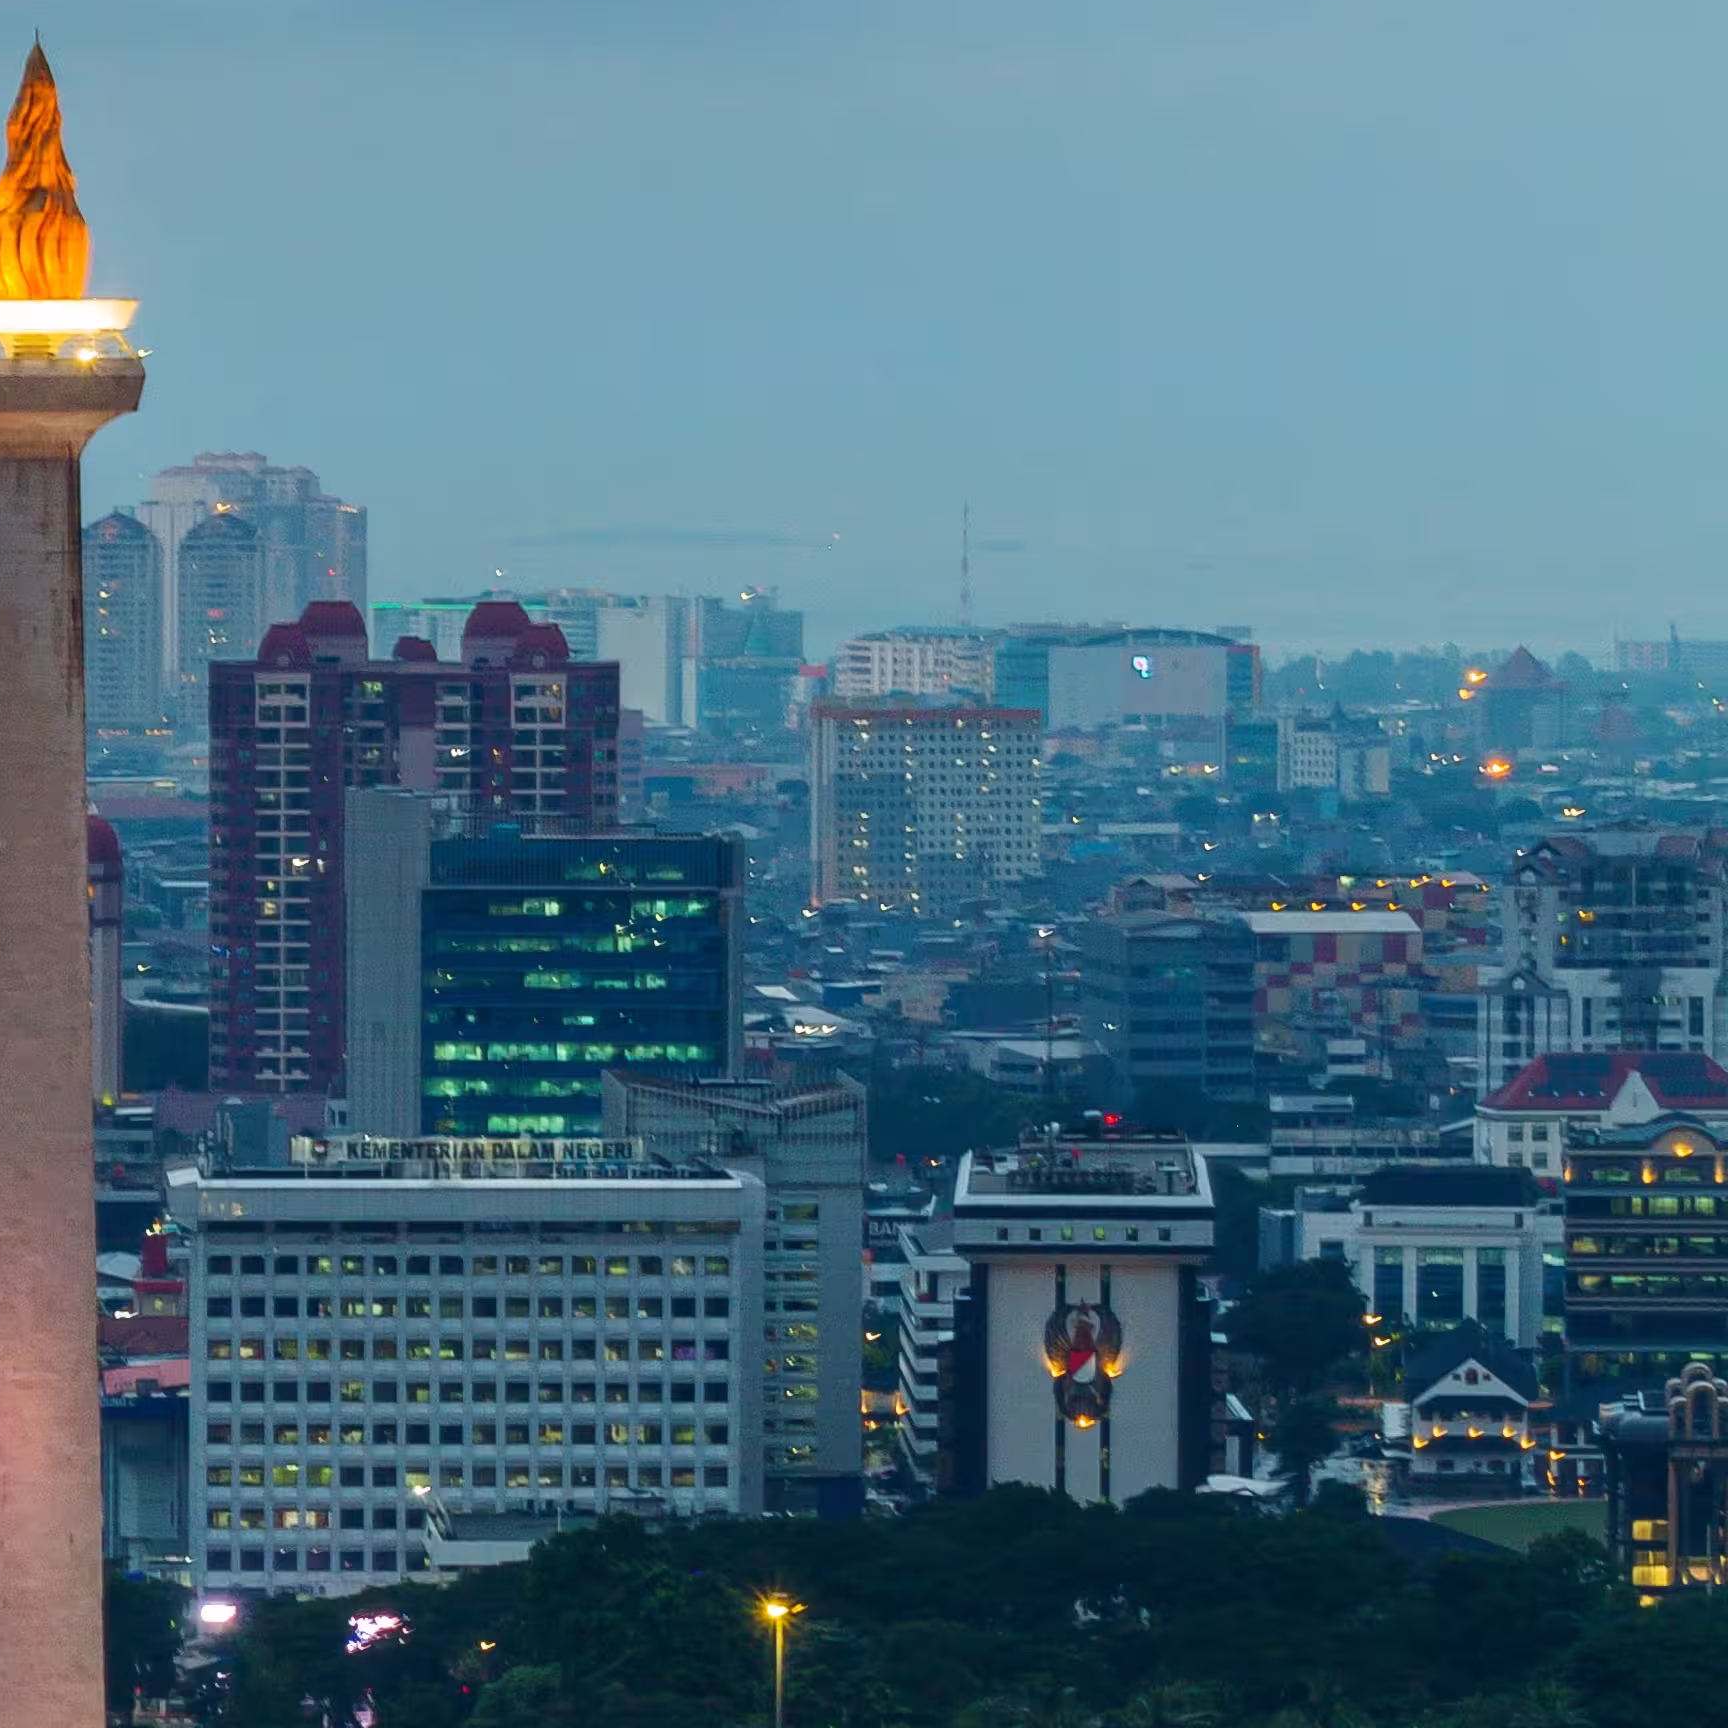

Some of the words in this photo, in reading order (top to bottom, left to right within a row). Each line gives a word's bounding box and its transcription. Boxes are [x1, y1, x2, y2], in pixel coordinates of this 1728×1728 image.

[347, 1141, 485, 1160] KEMENTERIAN
[492, 1141, 555, 1160] DALAM
[563, 1141, 633, 1160] NEGERI
